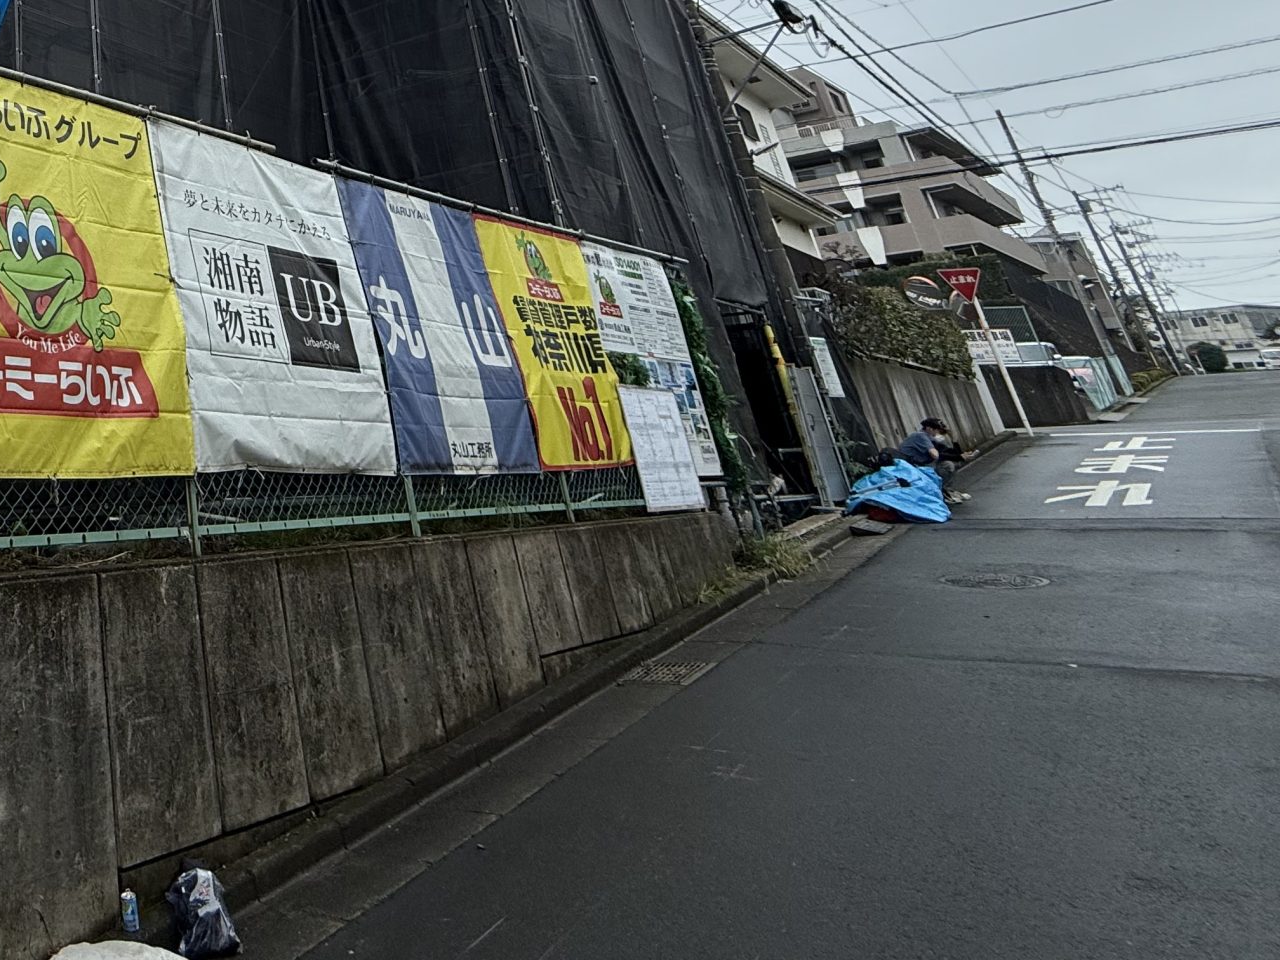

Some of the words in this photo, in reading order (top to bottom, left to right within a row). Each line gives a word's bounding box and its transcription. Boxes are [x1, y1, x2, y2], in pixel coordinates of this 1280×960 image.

[183, 189, 331, 241] 夢と未来をカタチにかえる
[203, 246, 264, 297] 湘南
[949, 274, 976, 284] 止まれ
[214, 297, 277, 349] 物語
[280, 272, 343, 327] UB
[16, 321, 38, 351] You
[40, 337, 59, 354] Me
[59, 330, 81, 352] Life
[451, 440, 494, 458] 丸山工務所
[1044, 436, 1177, 507] 止まれ
